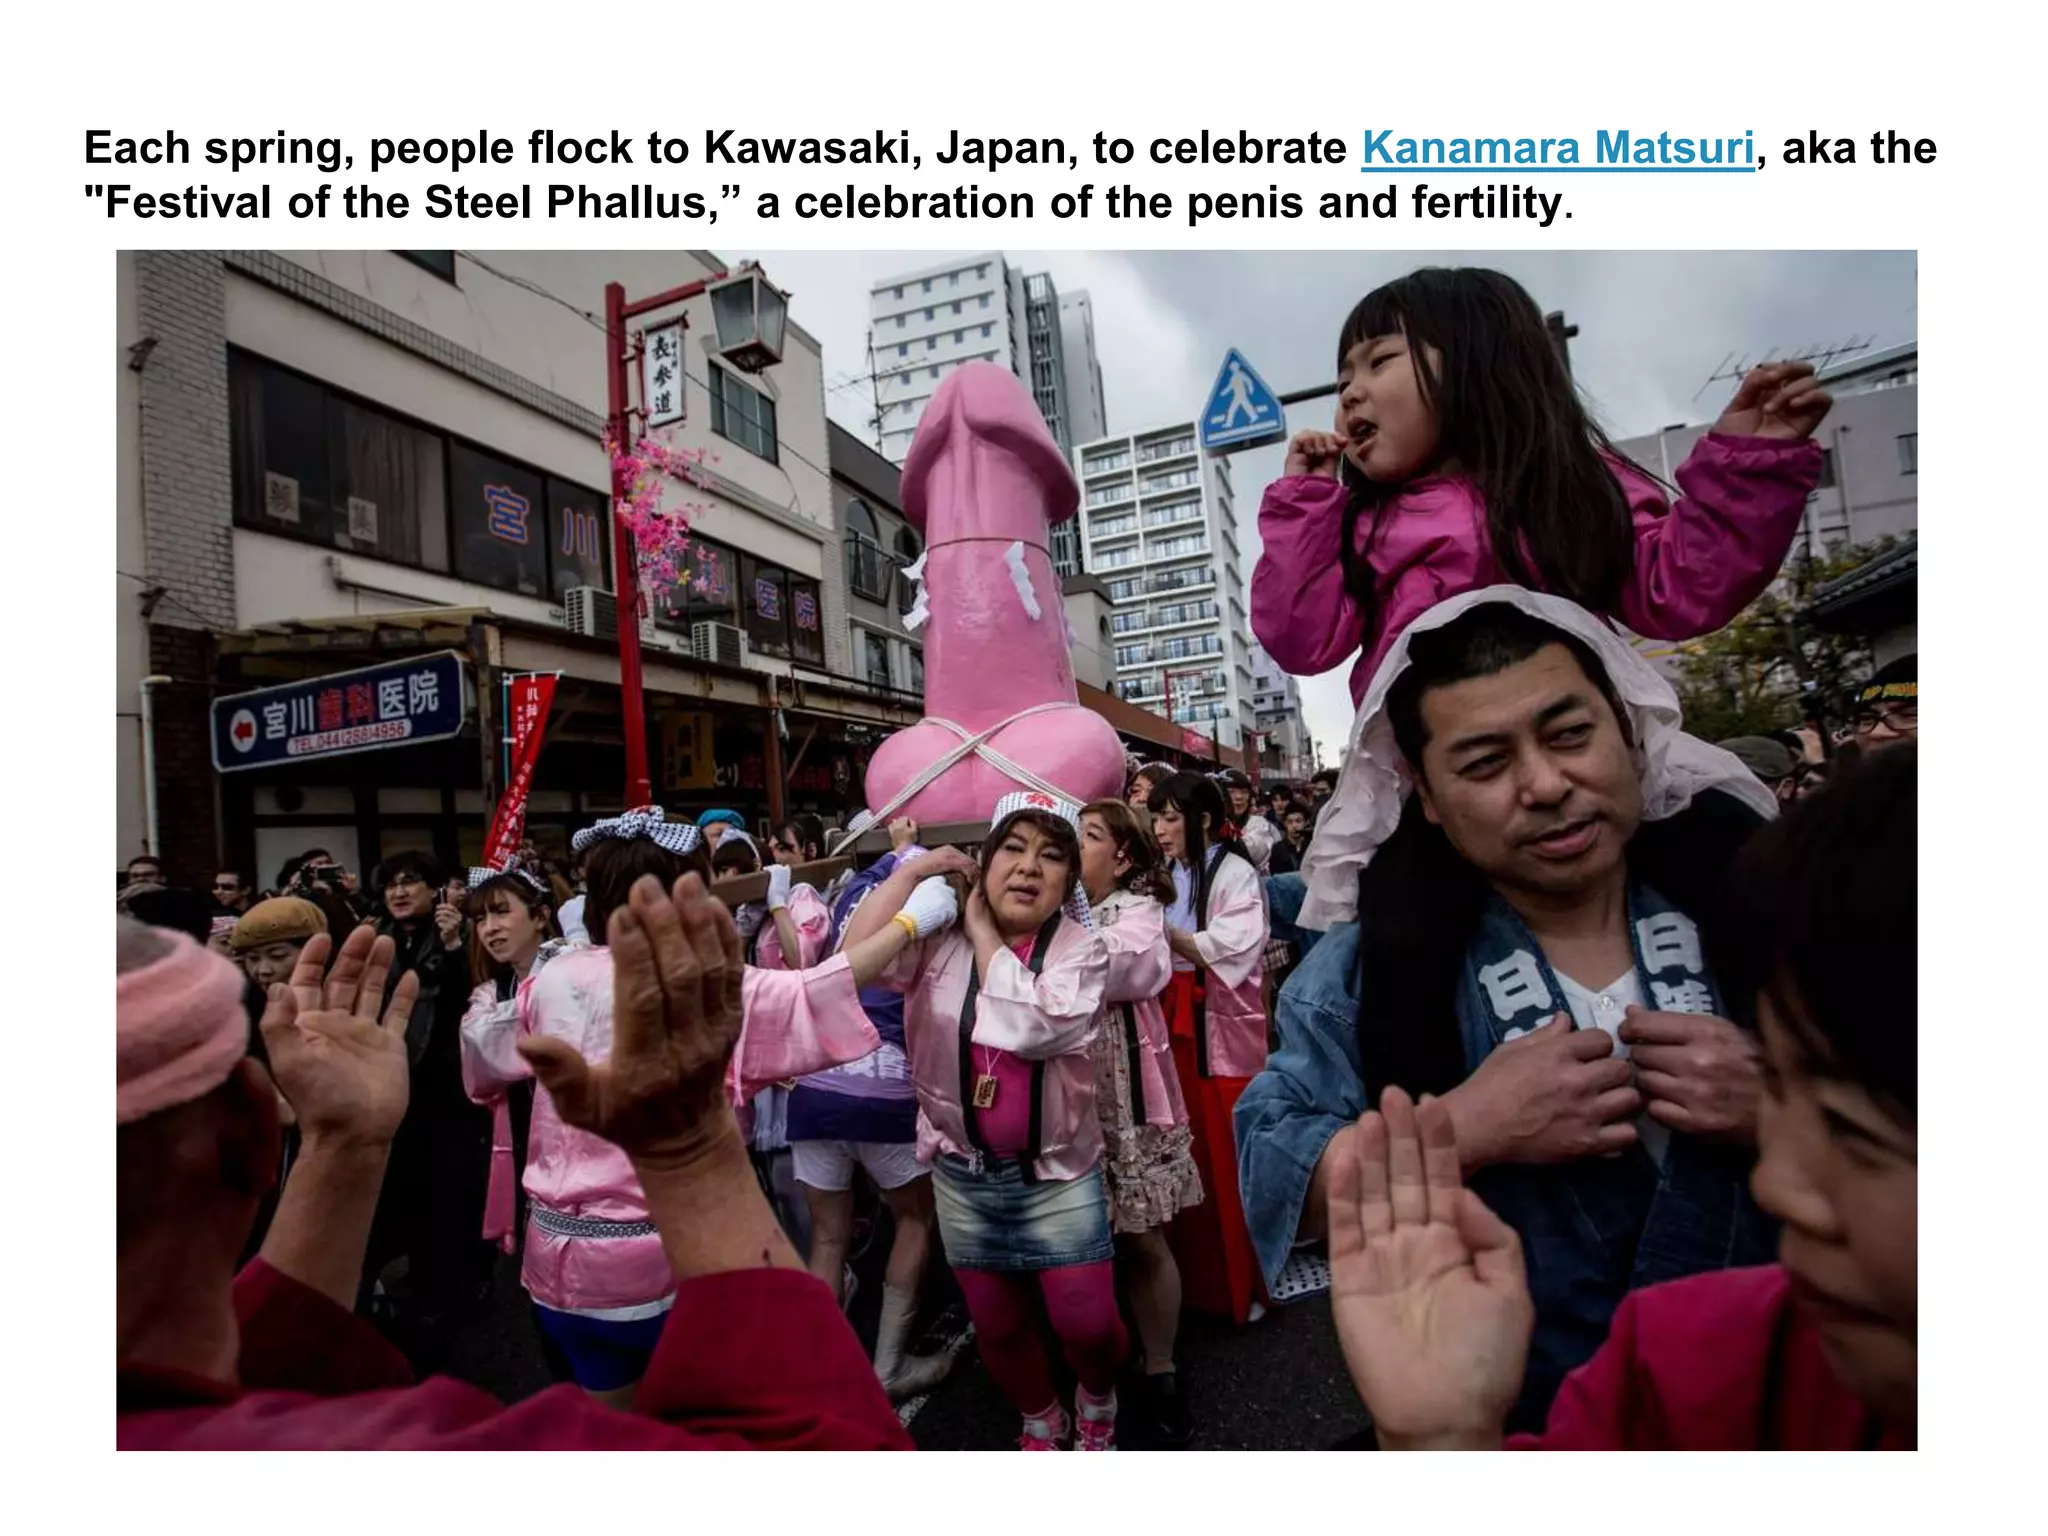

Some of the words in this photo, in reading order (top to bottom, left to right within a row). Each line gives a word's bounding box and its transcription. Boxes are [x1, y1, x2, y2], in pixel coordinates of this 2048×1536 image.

[652, 335, 673, 415] 表参道
[262, 669, 440, 740] 宮川歯科医院
[1478, 948, 1556, 1043] 日
